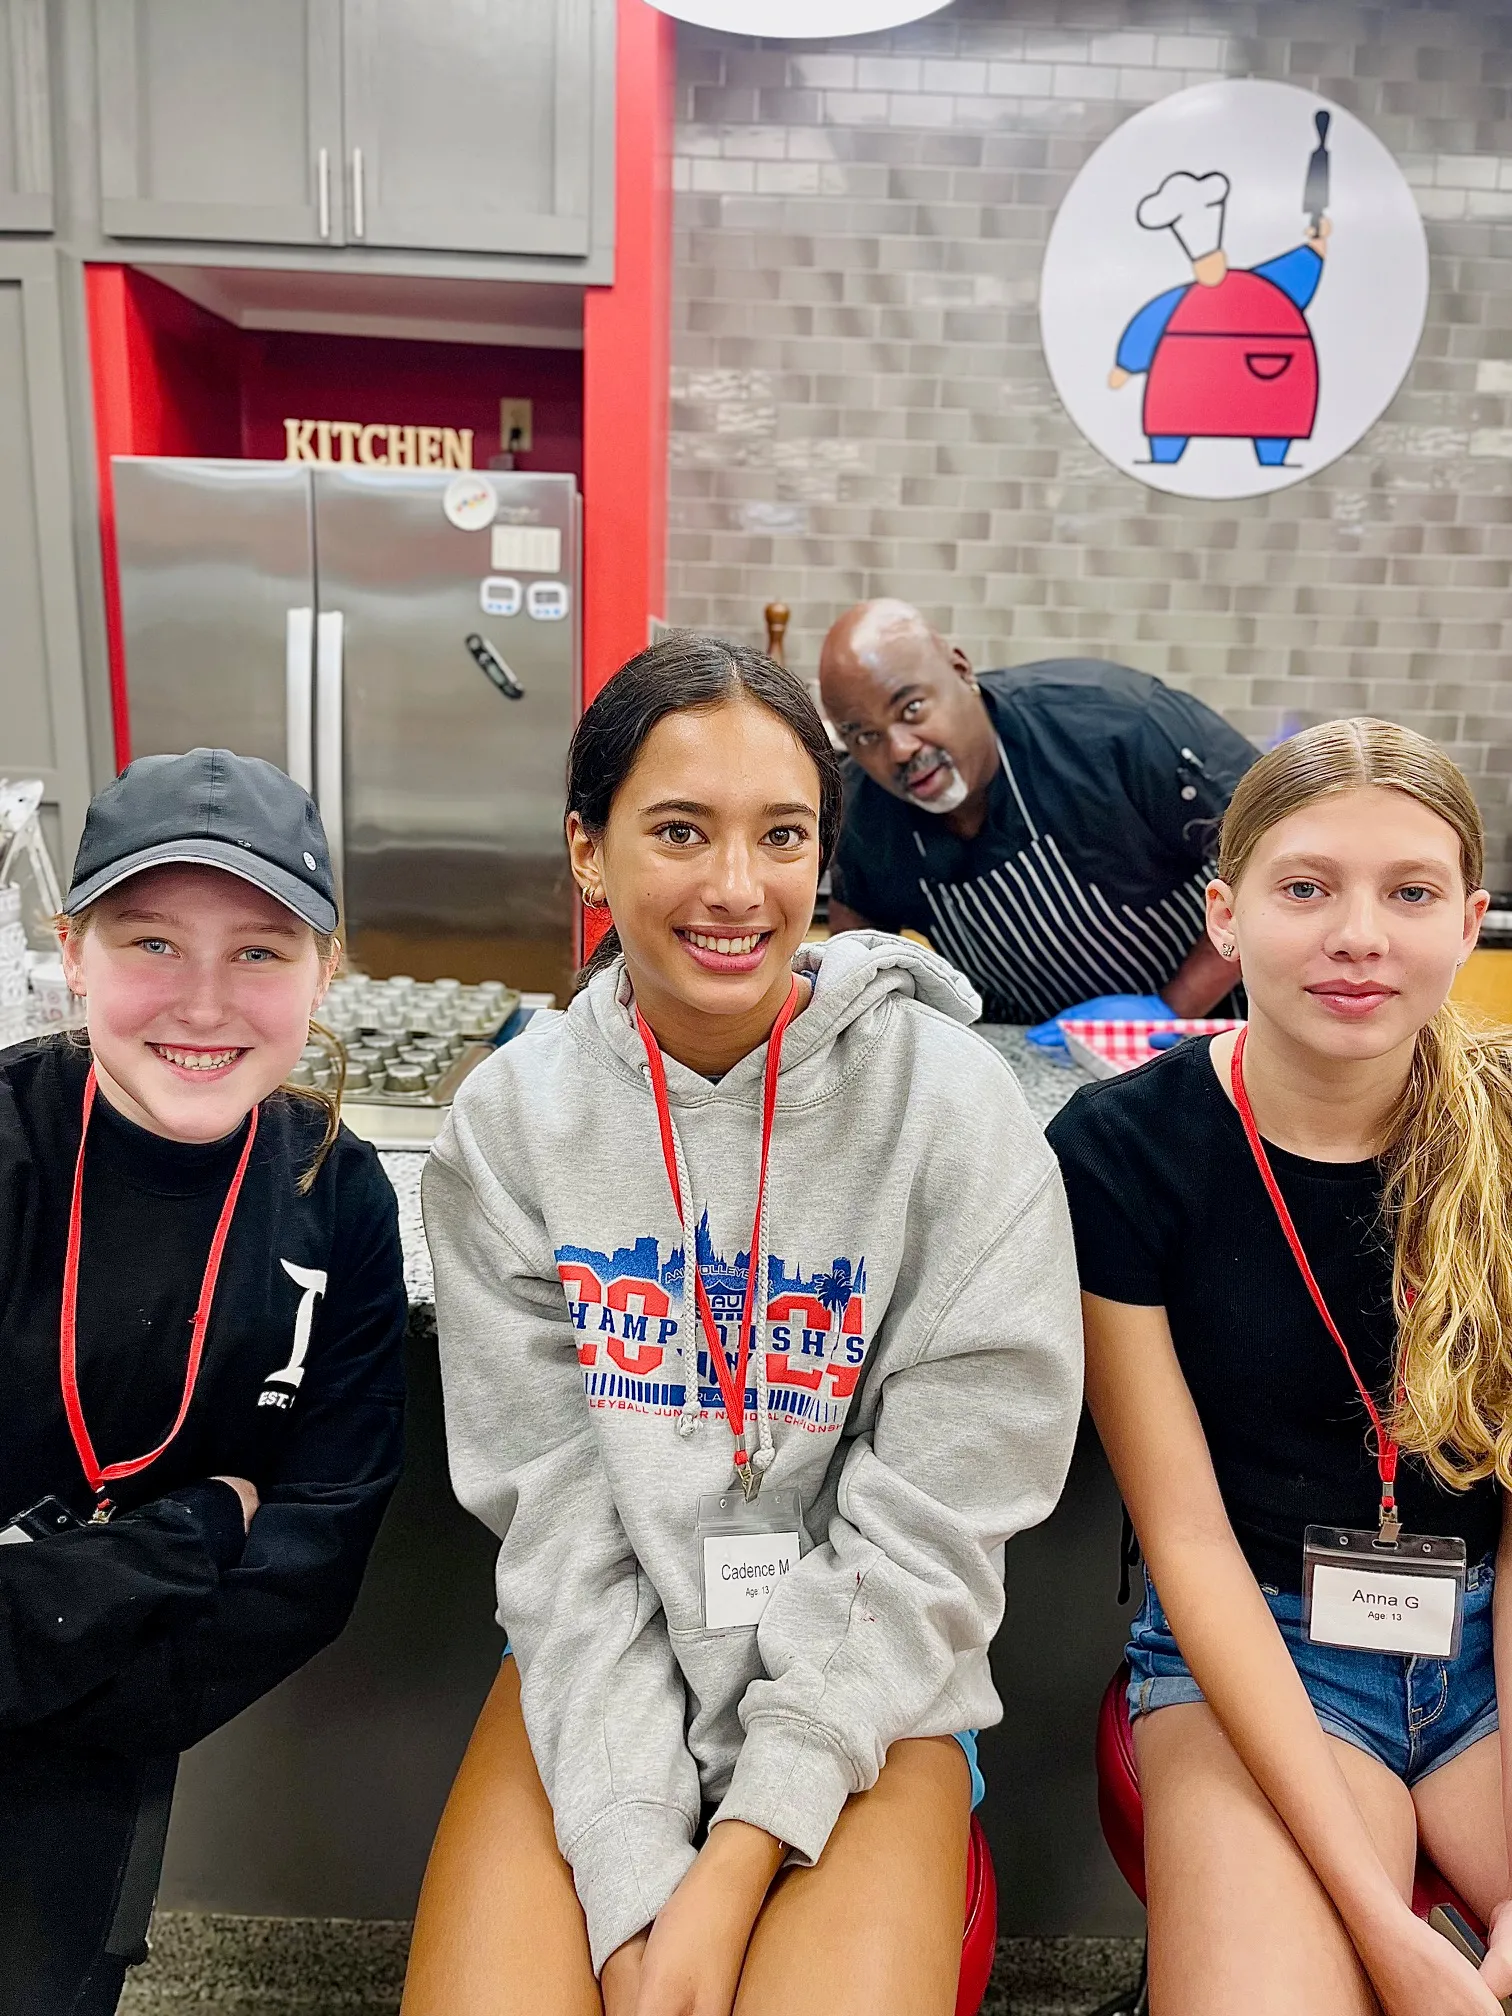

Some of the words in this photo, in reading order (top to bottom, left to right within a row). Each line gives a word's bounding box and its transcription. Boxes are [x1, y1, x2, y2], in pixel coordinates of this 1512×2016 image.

[283, 418, 474, 470] KITCHEN
[257, 1391, 288, 1409] EST.
[589, 1398, 649, 1414] LEYBALL
[654, 1407, 709, 1419] JUNR
[721, 1562, 776, 1581] Cadence
[778, 1558, 790, 1576] M
[761, 1585, 770, 1595] 13
[1351, 1588, 1399, 1607] Anna
[1404, 1595, 1420, 1610] G
[1391, 1612, 1403, 1622] 13
